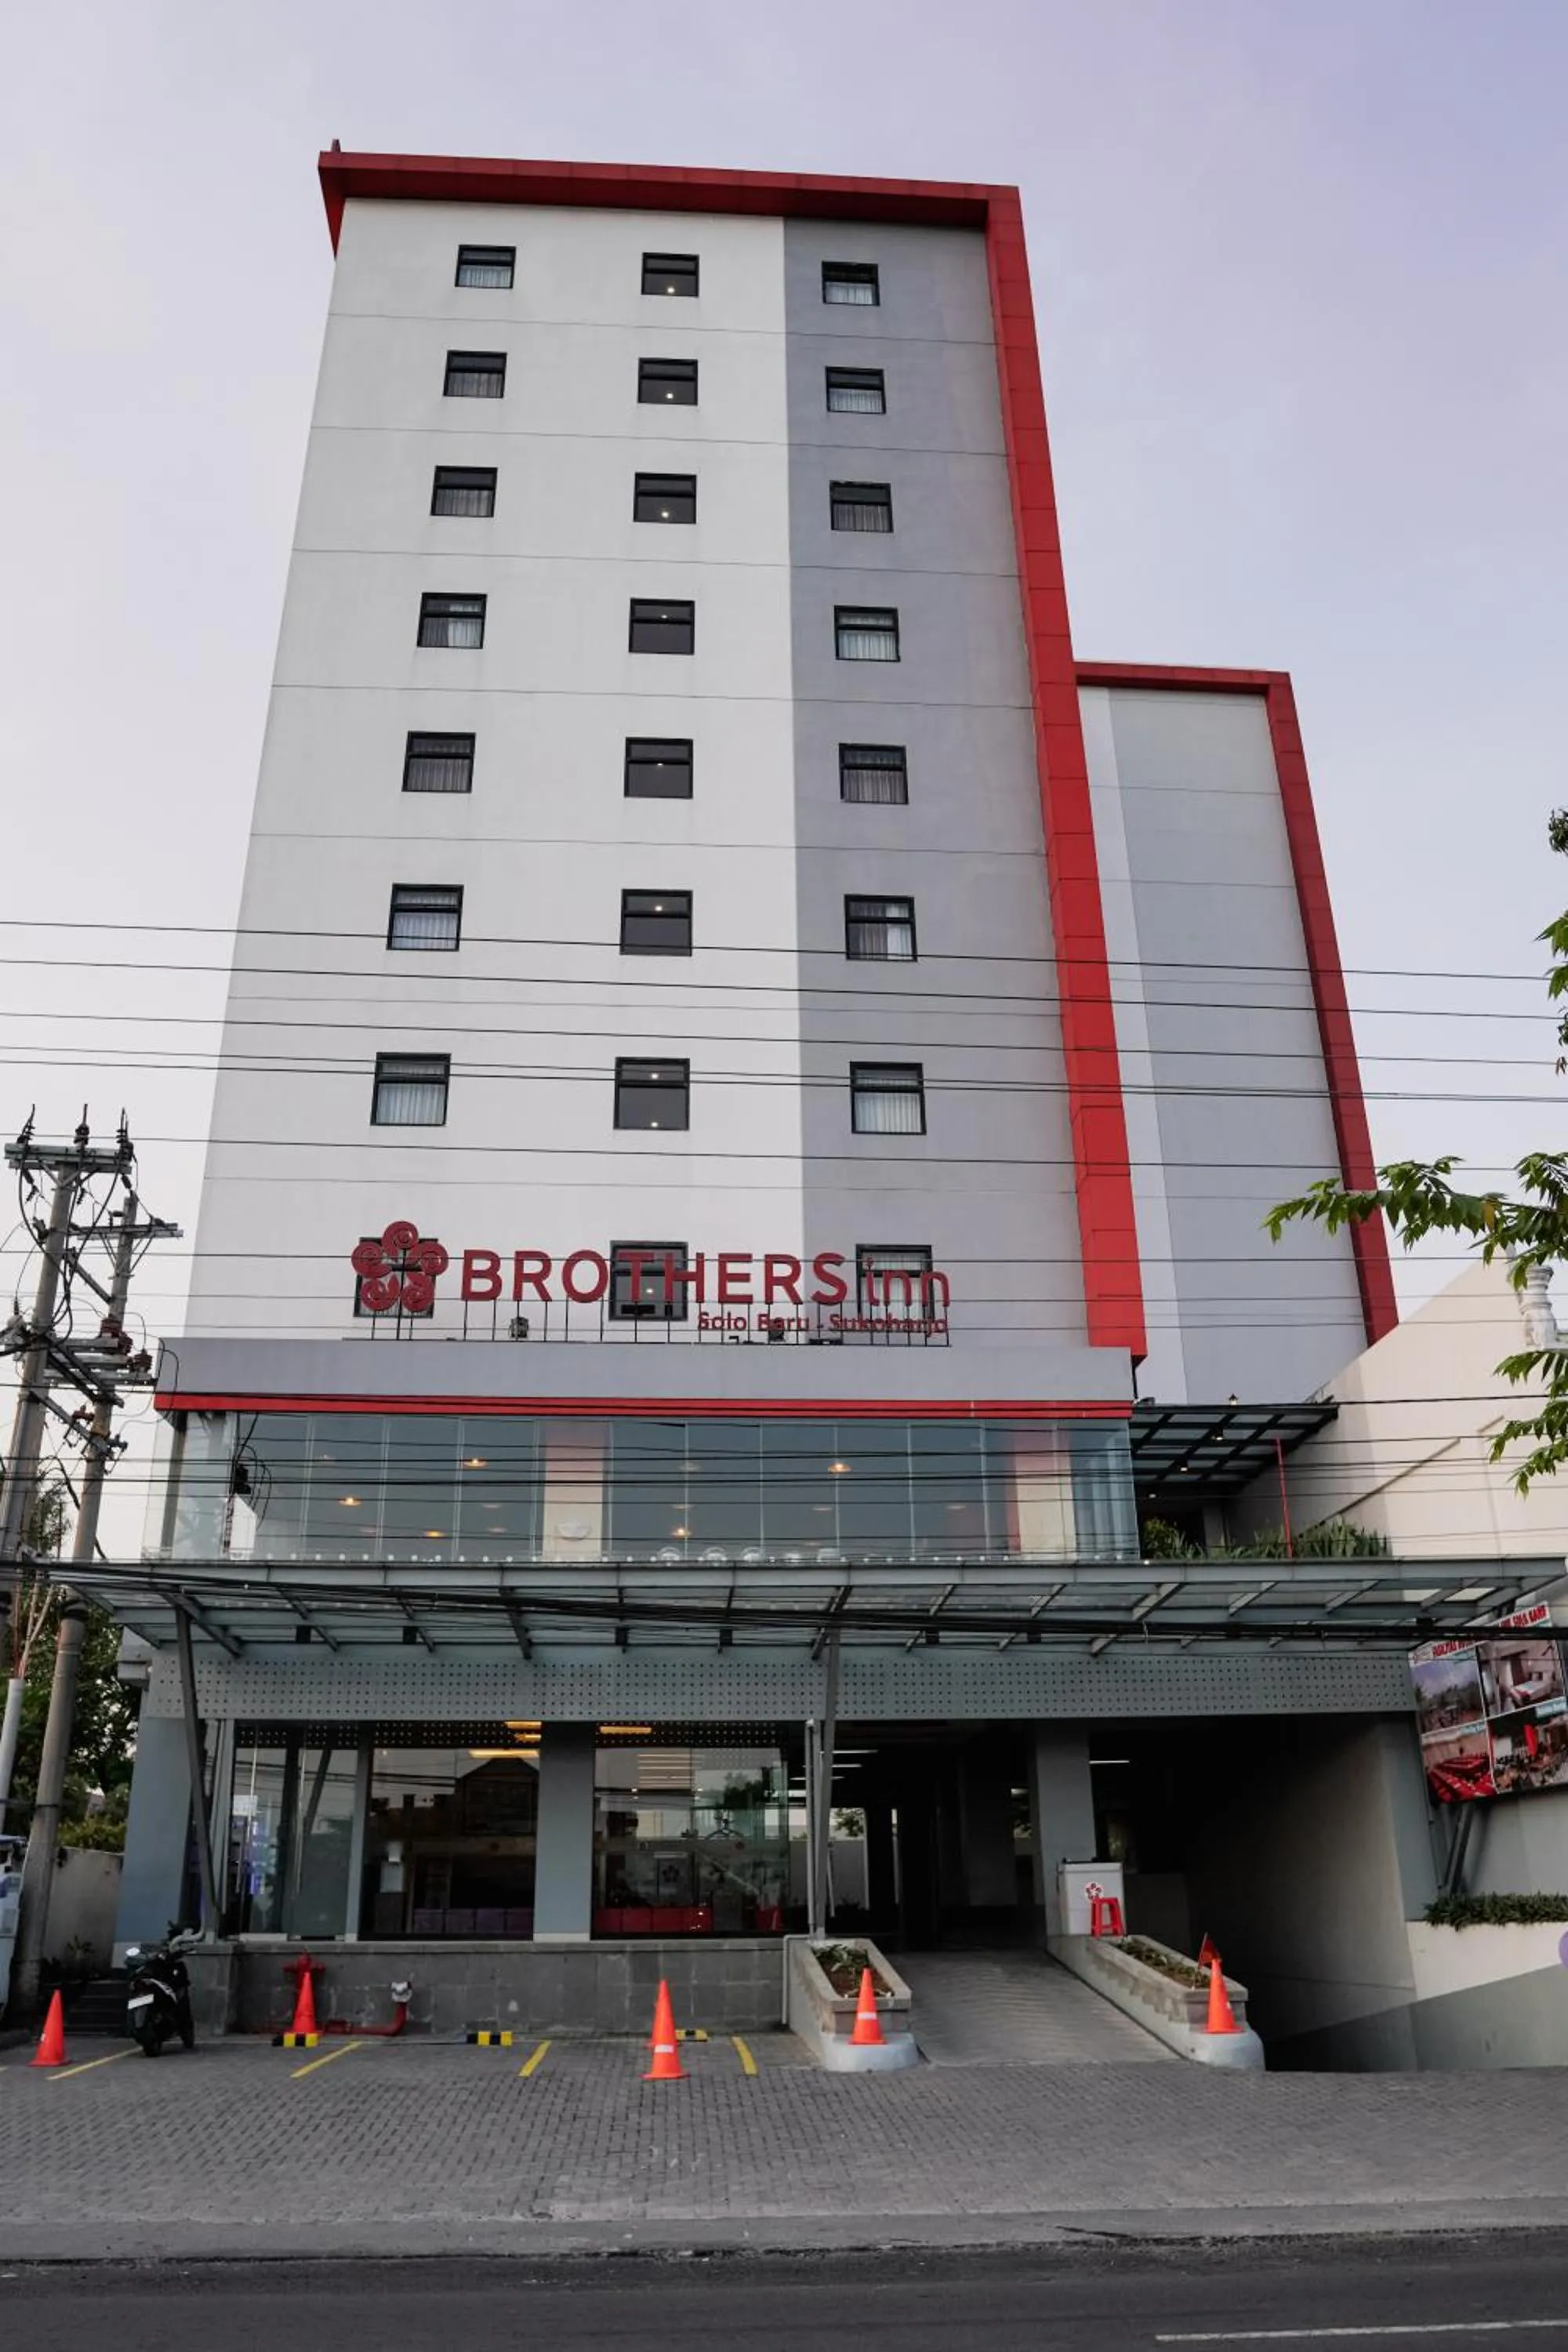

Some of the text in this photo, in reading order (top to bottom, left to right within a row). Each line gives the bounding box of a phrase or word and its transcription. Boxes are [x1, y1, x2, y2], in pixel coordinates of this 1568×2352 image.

[462, 1249, 951, 1307] BROTHERS inn
[697, 1311, 747, 1331] Solo
[757, 1312, 810, 1332] Baru
